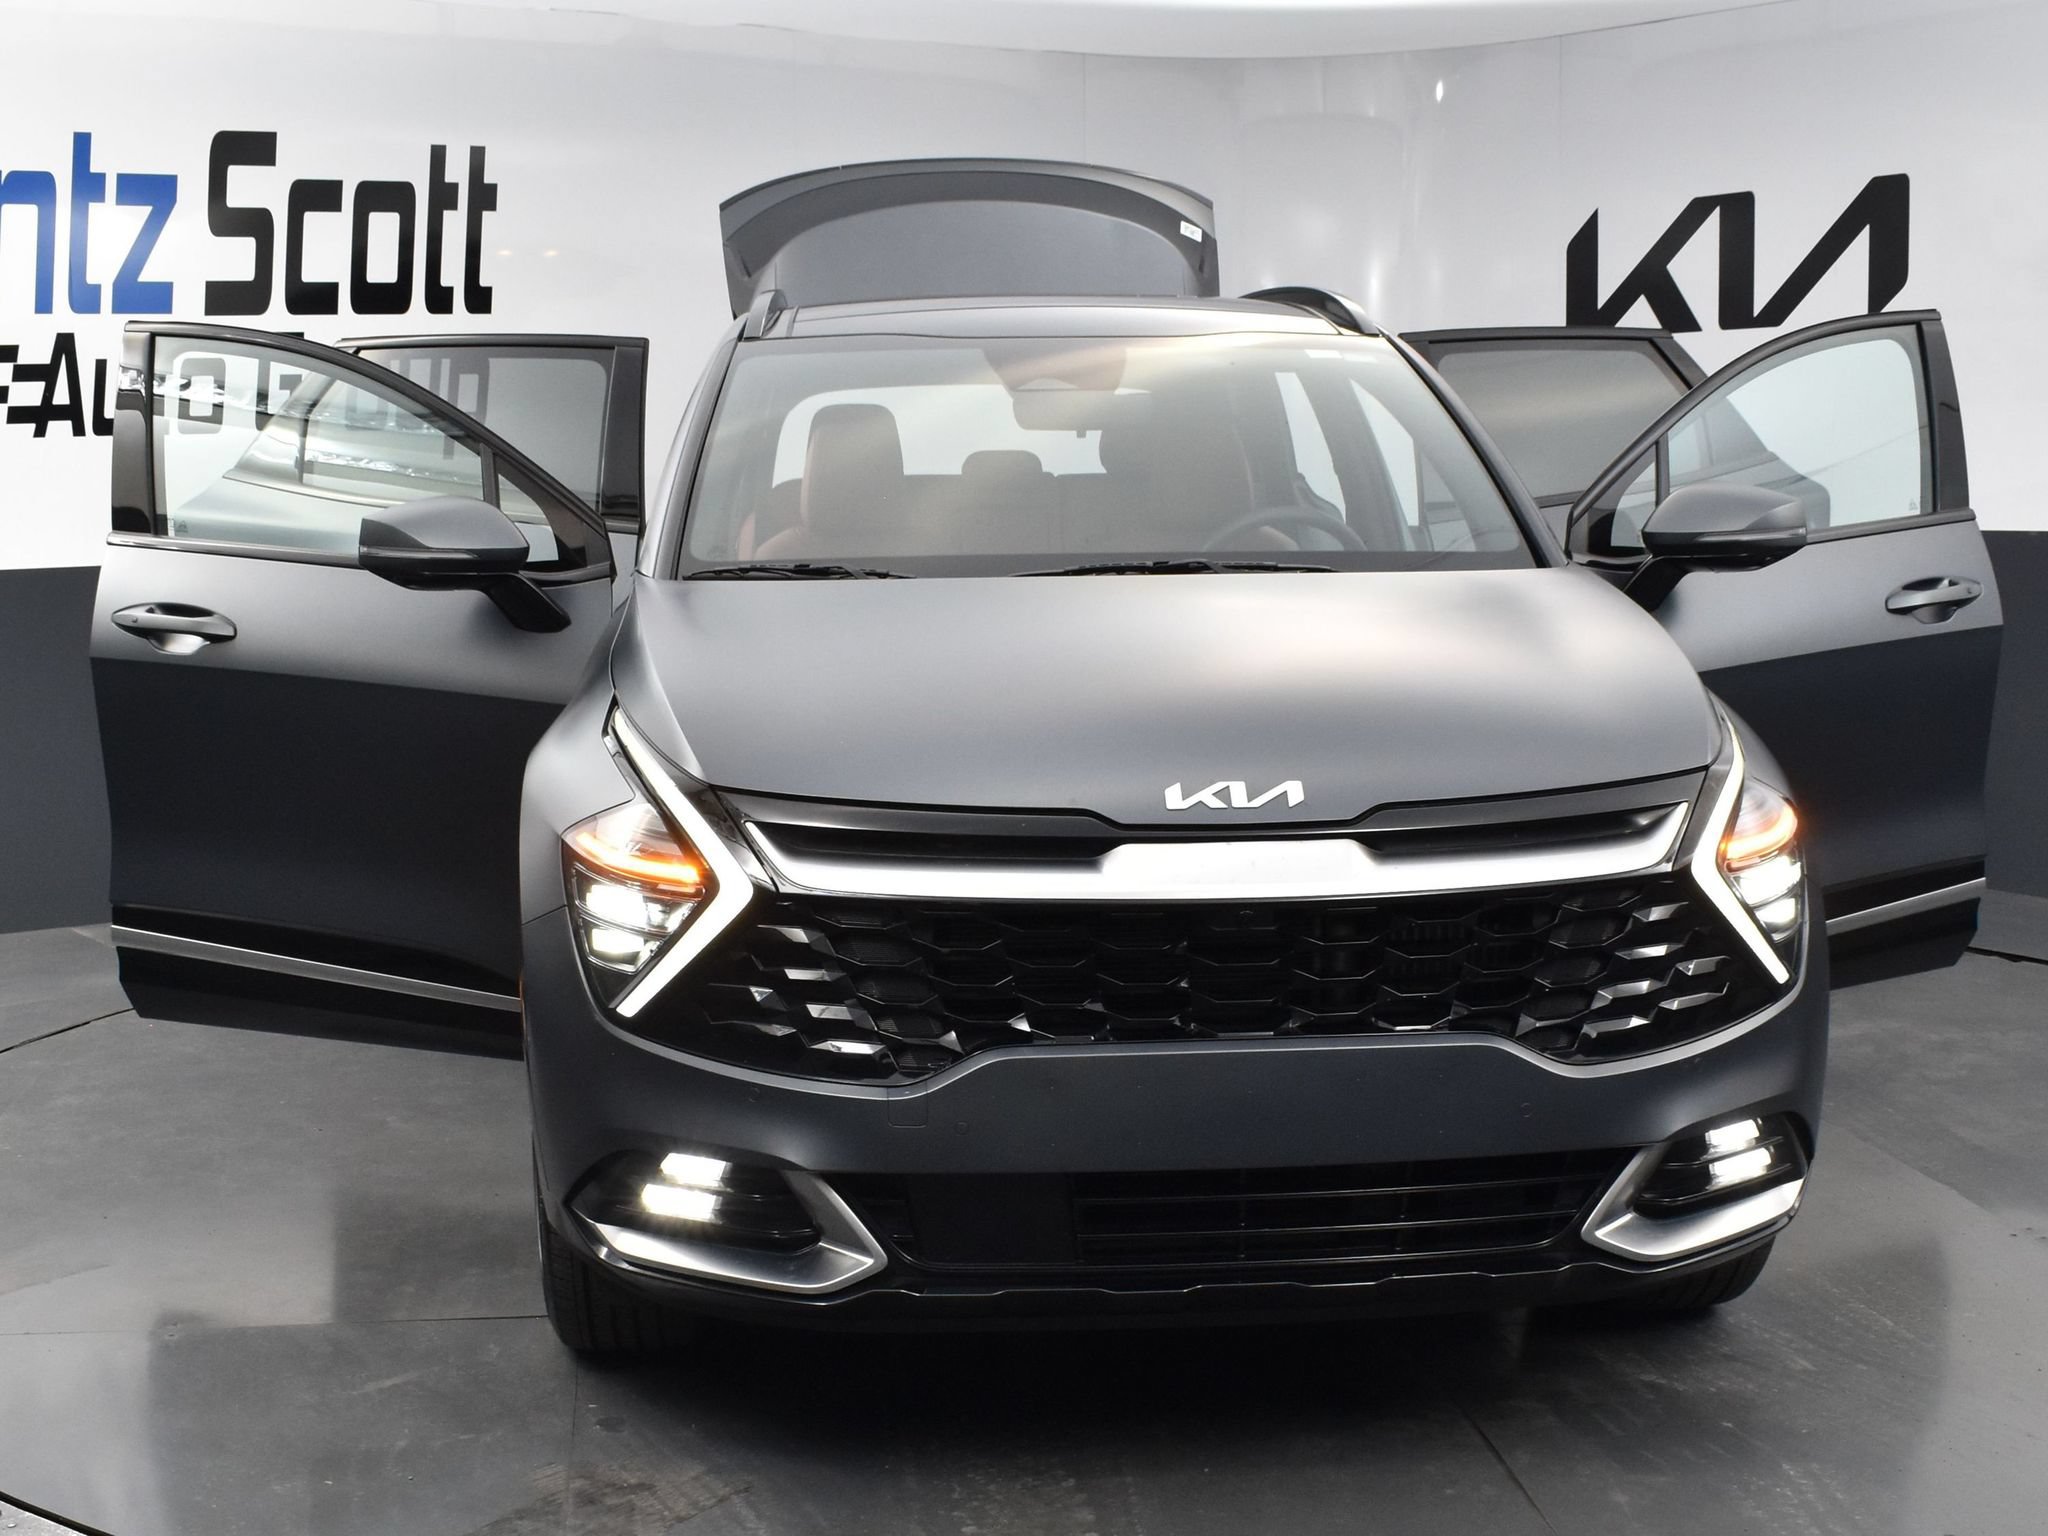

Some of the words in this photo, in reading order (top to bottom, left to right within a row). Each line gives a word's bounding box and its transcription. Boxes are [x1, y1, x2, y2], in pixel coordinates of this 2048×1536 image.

[204, 130, 498, 315] Scott
[1566, 173, 1910, 333] KIA
[255, 332, 490, 460] Goup
[1164, 780, 1305, 810] KIA
